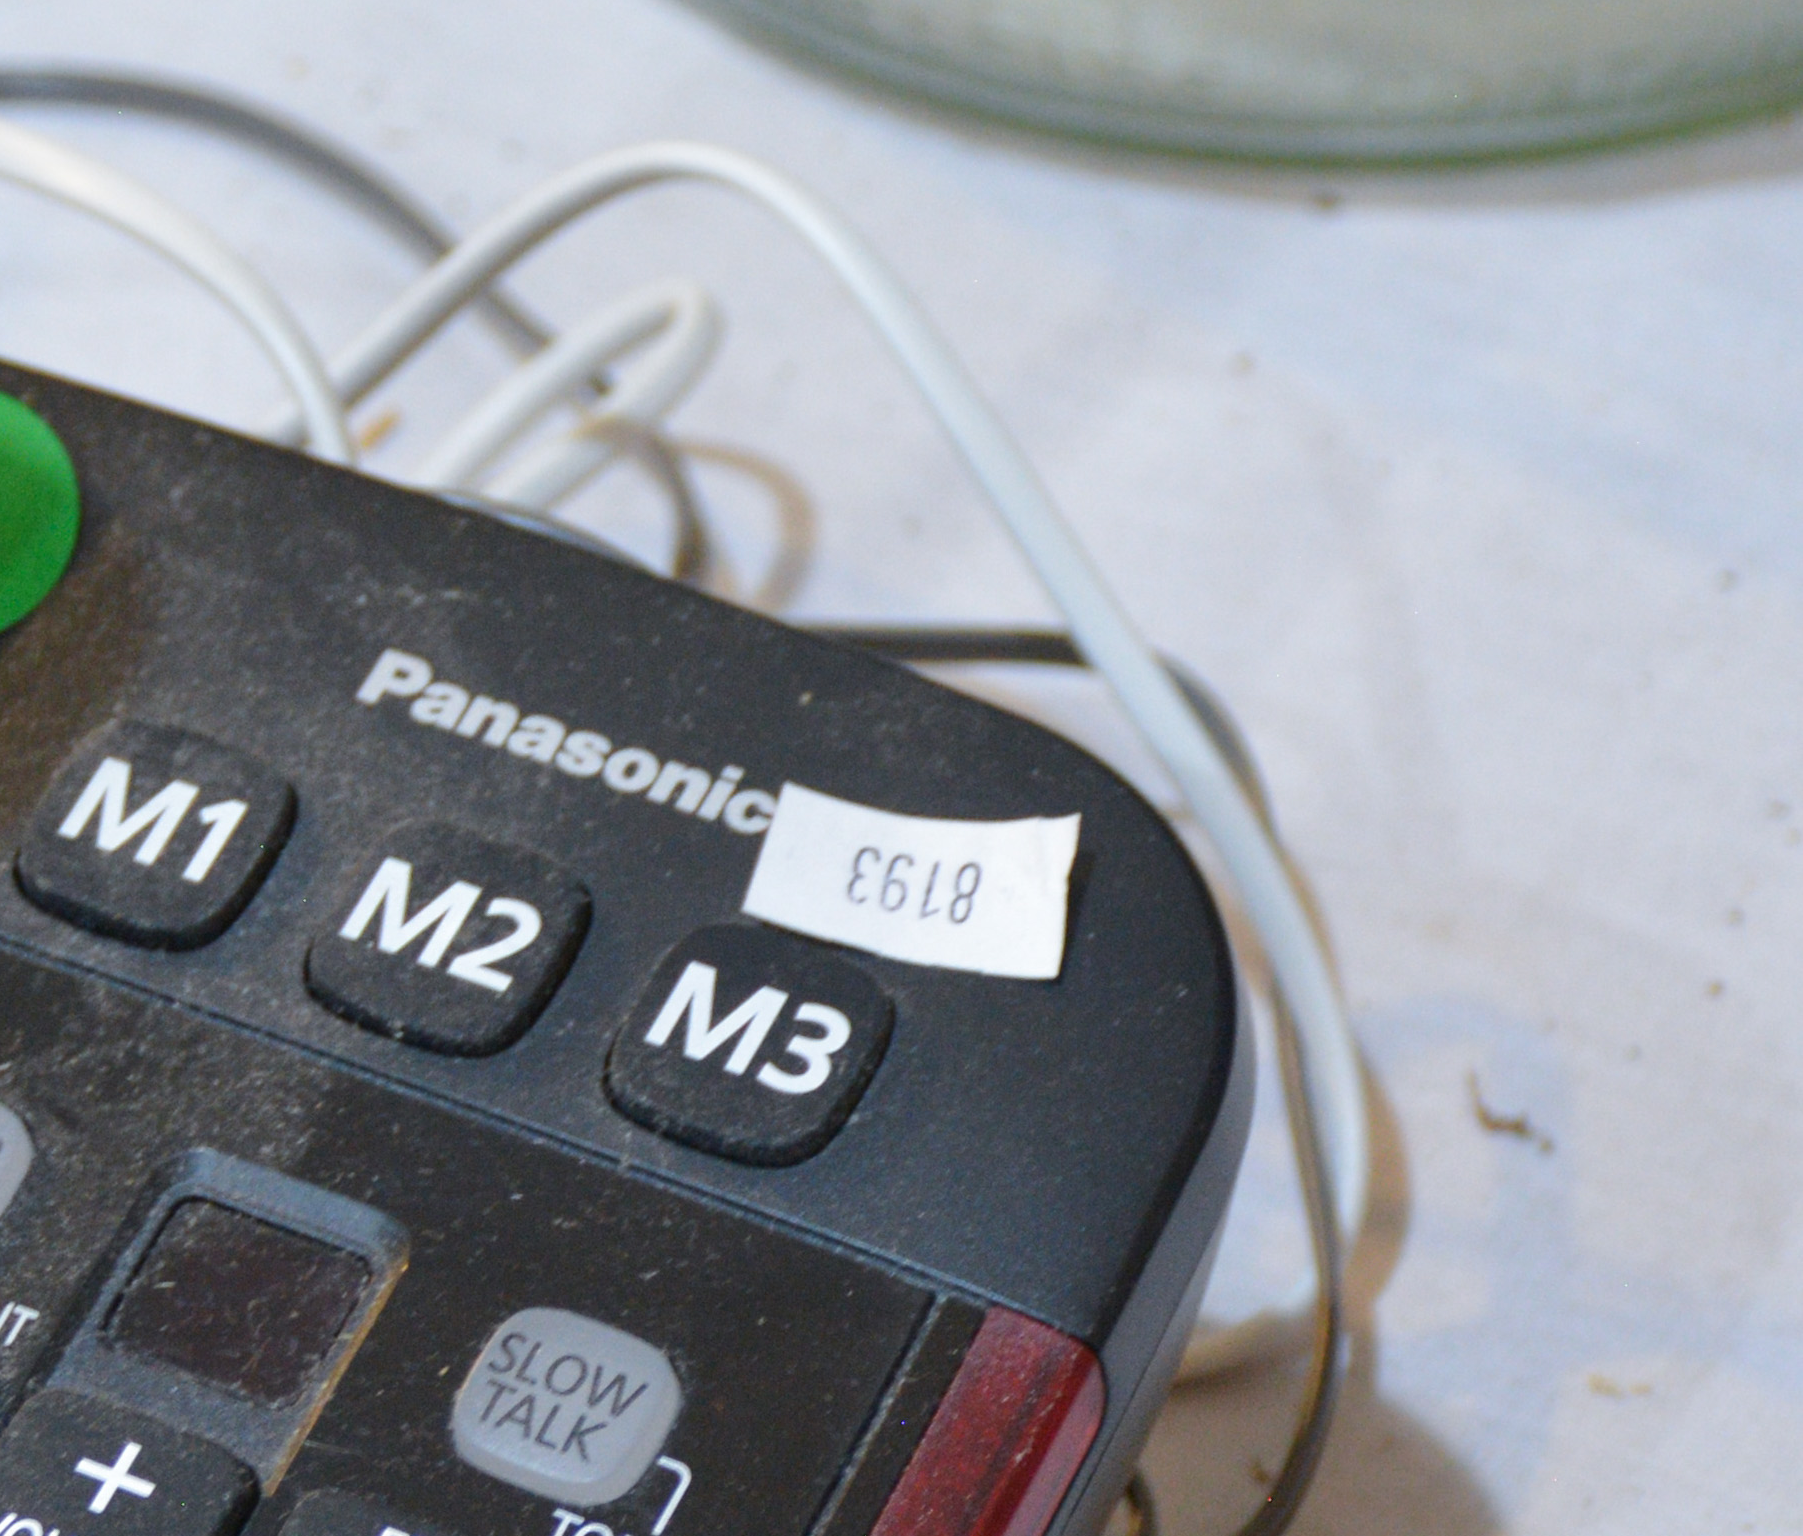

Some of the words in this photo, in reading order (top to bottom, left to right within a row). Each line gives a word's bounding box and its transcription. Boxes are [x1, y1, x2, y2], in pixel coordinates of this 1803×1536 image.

[355, 649, 780, 836] Panasonic
[58, 756, 249, 884] M1
[338, 857, 542, 993] M2
[846, 845, 984, 924] 8193
[644, 960, 852, 1096] M3
[478, 1379, 609, 1463] TALK
[487, 1331, 649, 1419] SLOW
